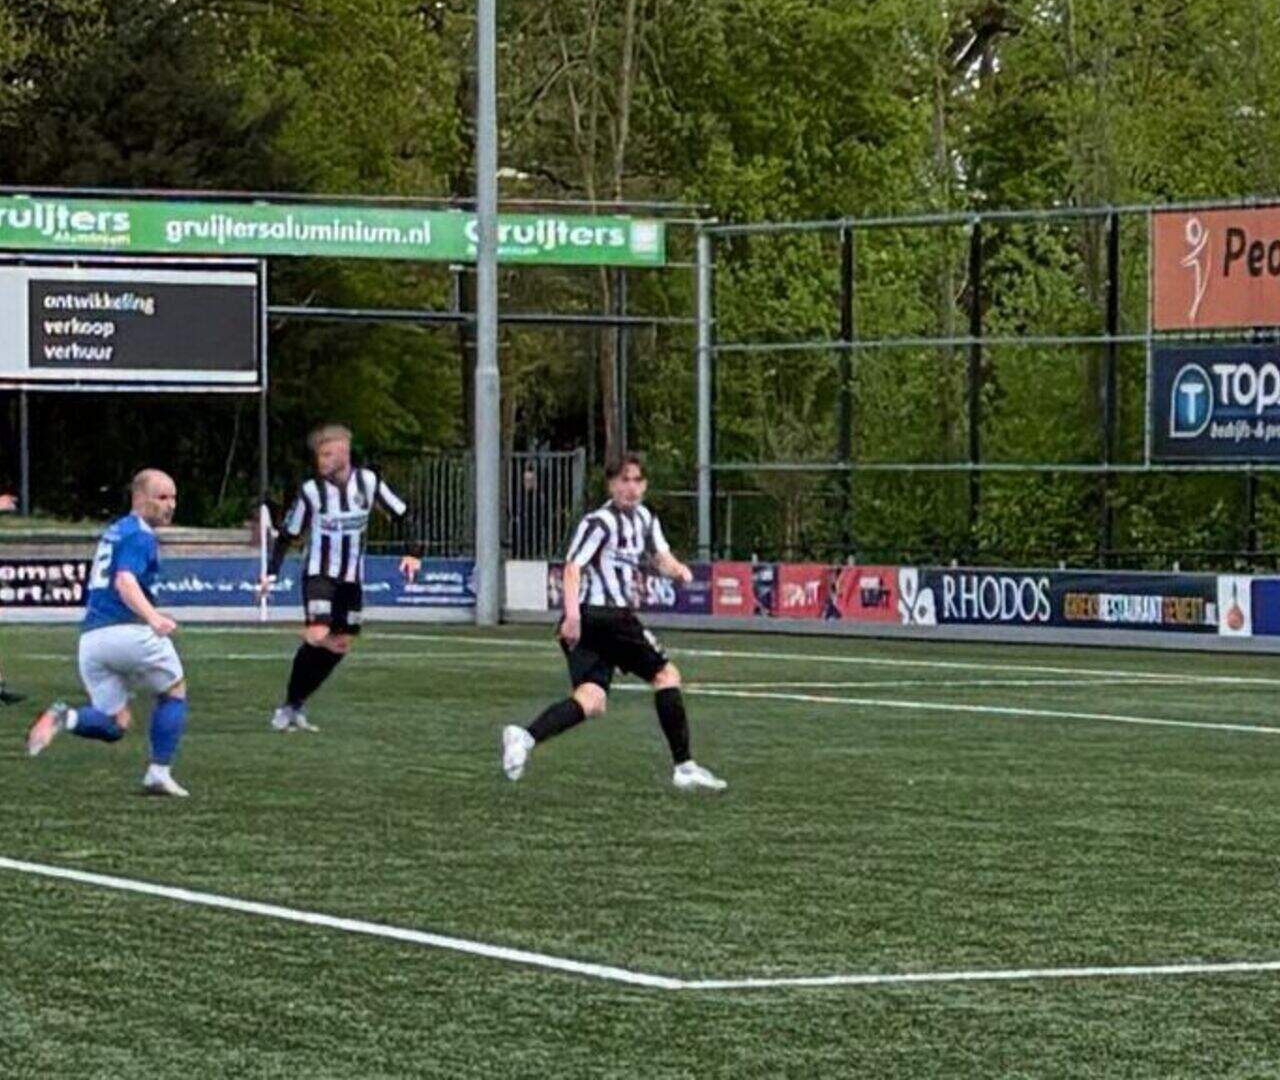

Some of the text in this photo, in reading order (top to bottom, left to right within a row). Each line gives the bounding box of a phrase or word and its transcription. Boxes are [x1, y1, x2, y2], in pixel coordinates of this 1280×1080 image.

[43, 293, 156, 315] ontwikkeling
[43, 318, 115, 337] verkoop
[43, 343, 113, 360] verhuur
[942, 574, 1051, 622] RHODOS
